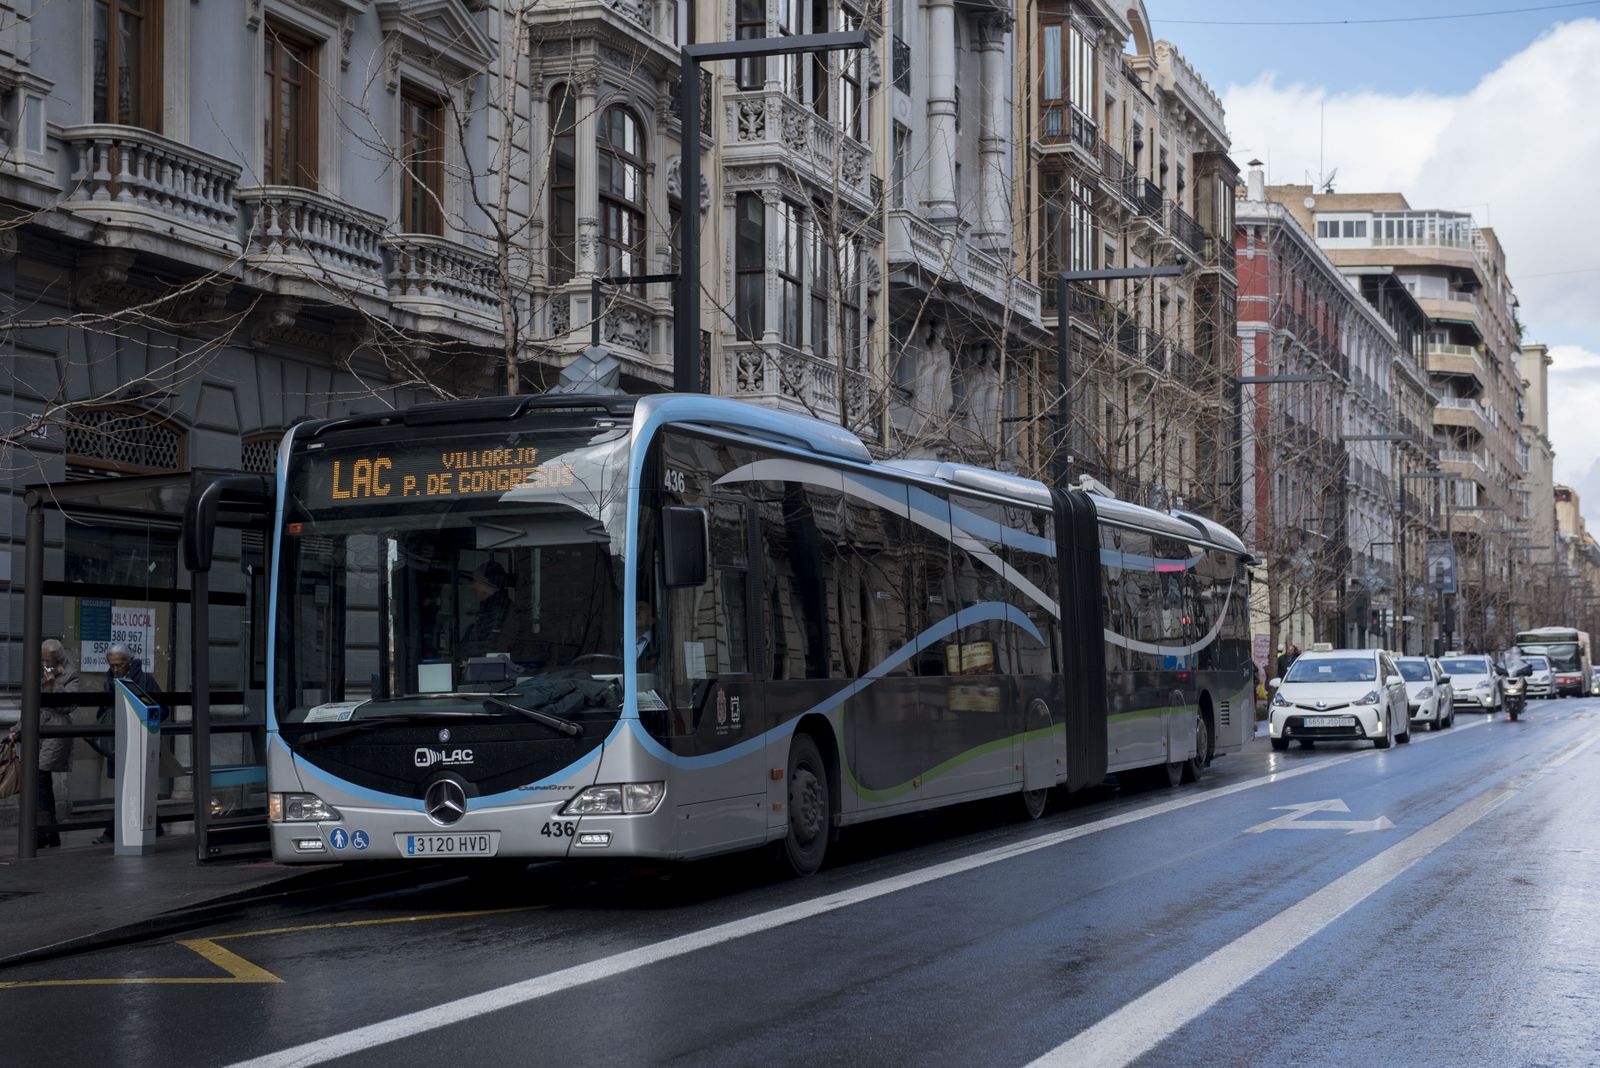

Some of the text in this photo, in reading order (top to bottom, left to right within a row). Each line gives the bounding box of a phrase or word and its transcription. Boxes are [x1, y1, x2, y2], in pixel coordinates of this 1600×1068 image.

[442, 447, 537, 469] VILLAREJO
[332, 457, 393, 499] LAC
[403, 464, 575, 497] P. DE CONGRESOS
[664, 469, 685, 493] 436
[129, 614, 151, 627] LOCAL
[112, 630, 142, 642] 380 967
[442, 749, 474, 761] LAC
[540, 821, 575, 838] 436
[417, 836, 487, 852] 3120 HVD
